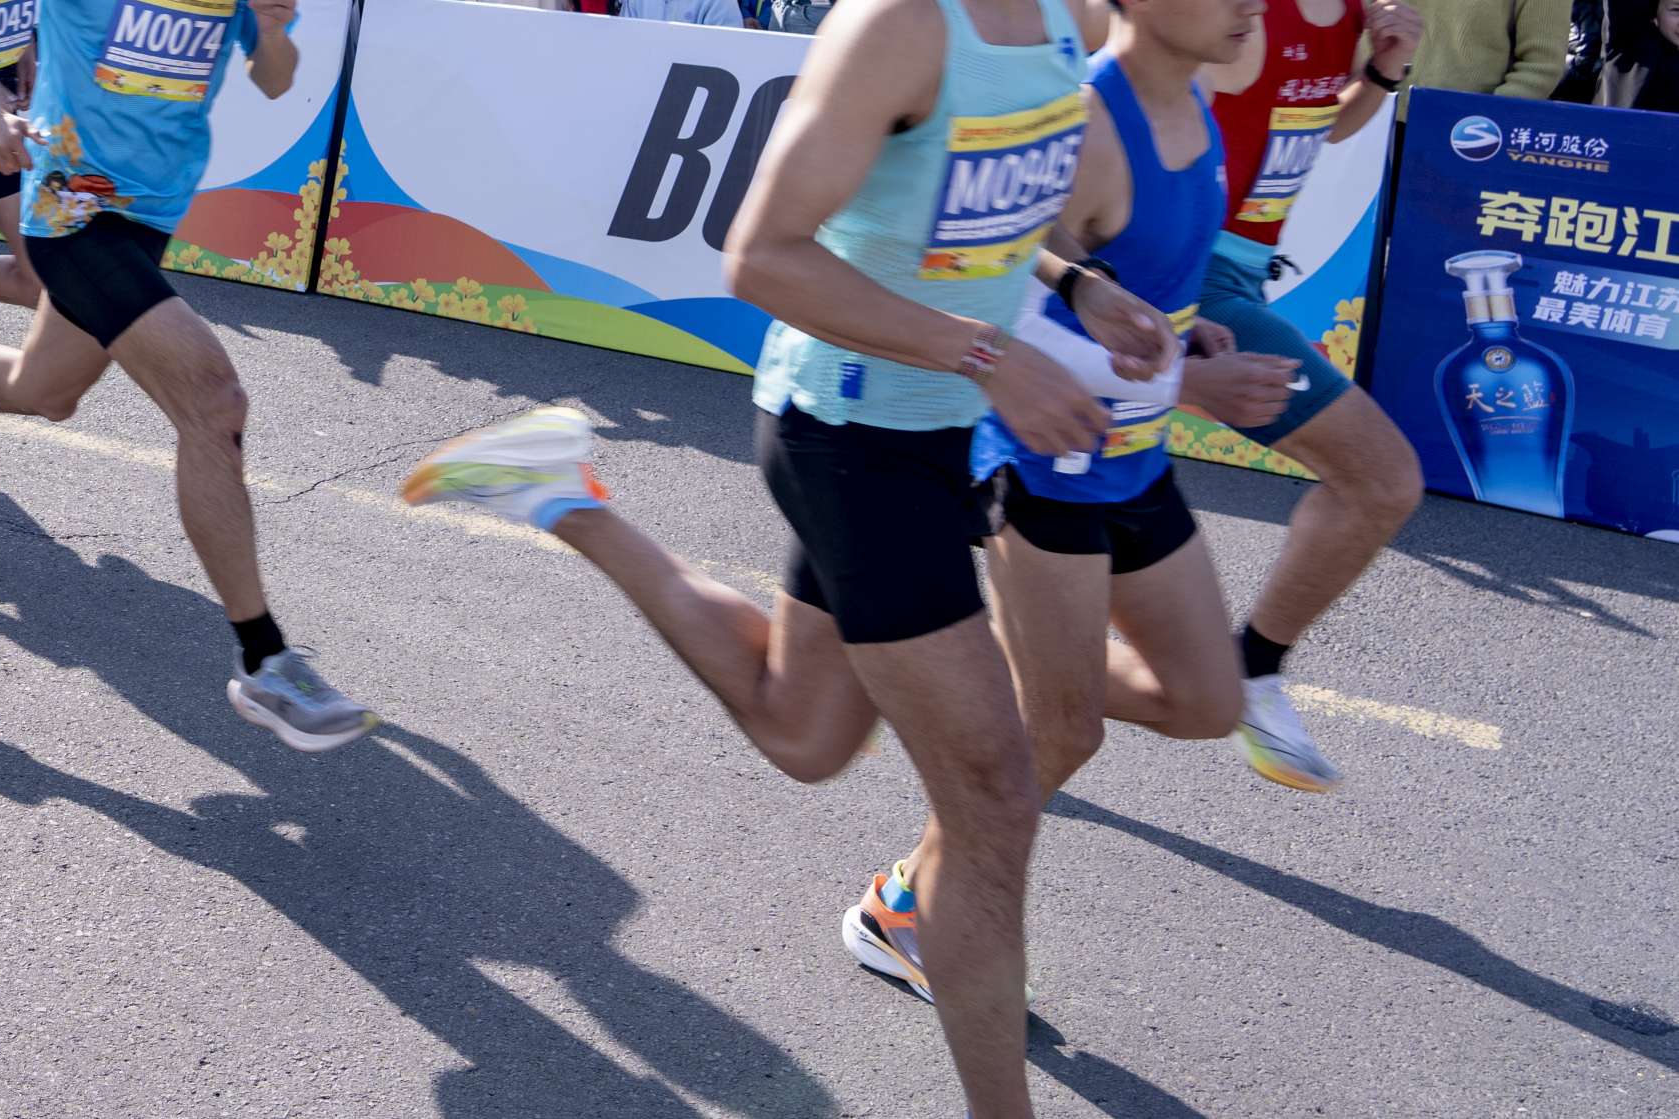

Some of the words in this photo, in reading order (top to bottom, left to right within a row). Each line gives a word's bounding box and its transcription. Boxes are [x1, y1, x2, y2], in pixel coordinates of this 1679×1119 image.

[113, 4, 227, 58] M0074
[1507, 152, 1610, 173] YANGHE
[1510, 127, 1610, 158] 洋河股份
[1476, 190, 1679, 265] 奔跑江
[1531, 296, 1671, 340] 最美体育
